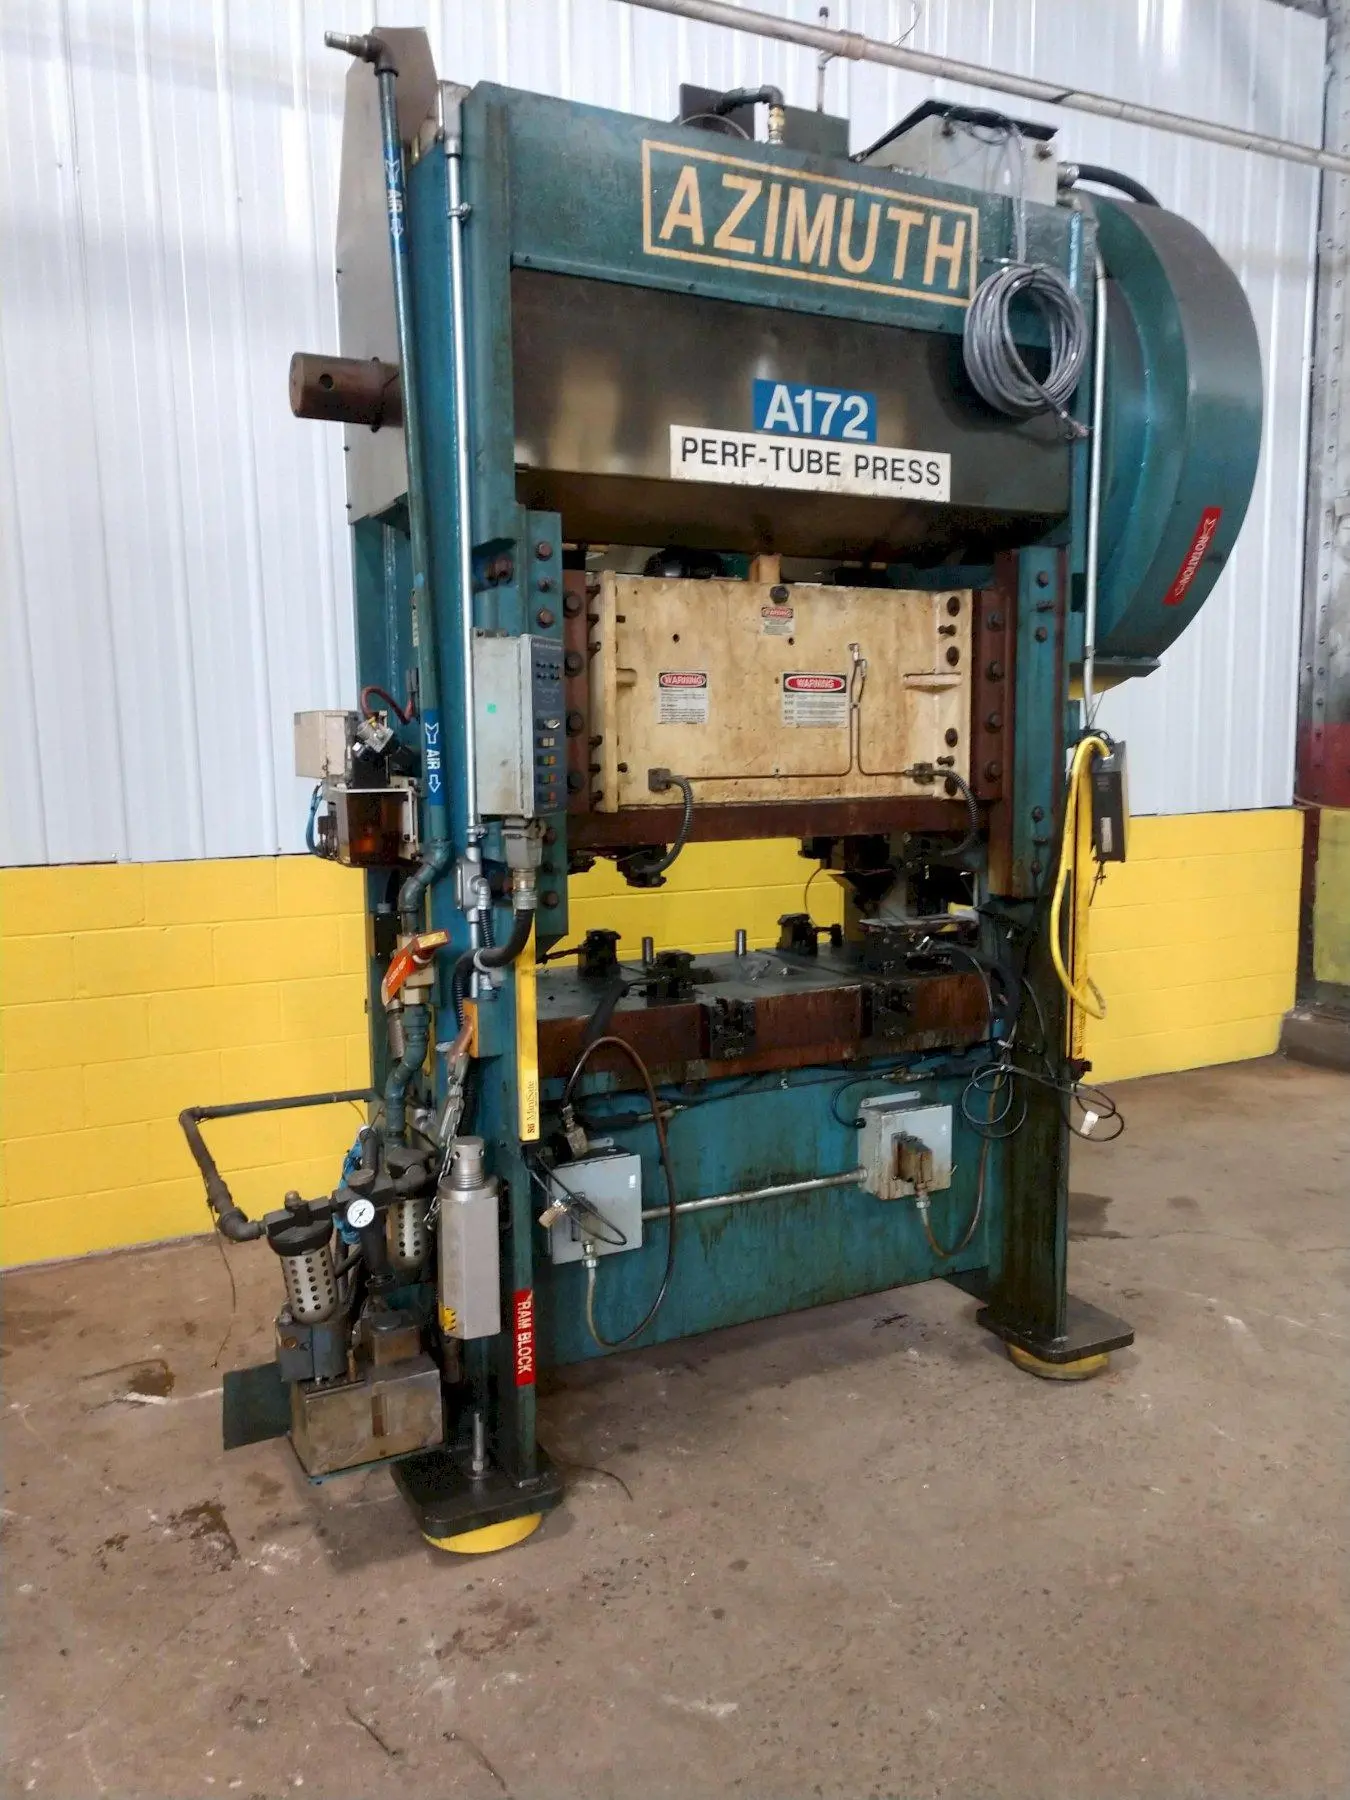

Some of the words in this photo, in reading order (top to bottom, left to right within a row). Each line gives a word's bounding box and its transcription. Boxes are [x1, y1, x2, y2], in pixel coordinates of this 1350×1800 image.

[387, 188, 403, 213] AIR
[658, 164, 966, 290] AZIMUTH
[763, 384, 869, 440] A172
[681, 436, 842, 476] PERF-TUBE
[854, 454, 941, 486] PRESS
[1180, 536, 1210, 584] ROTATION
[664, 675, 703, 686] WARNING
[796, 678, 835, 689] WARNING
[426, 748, 440, 770] AIR
[517, 1301, 532, 1330] RAM
[517, 1331, 533, 1375] BLOCK
